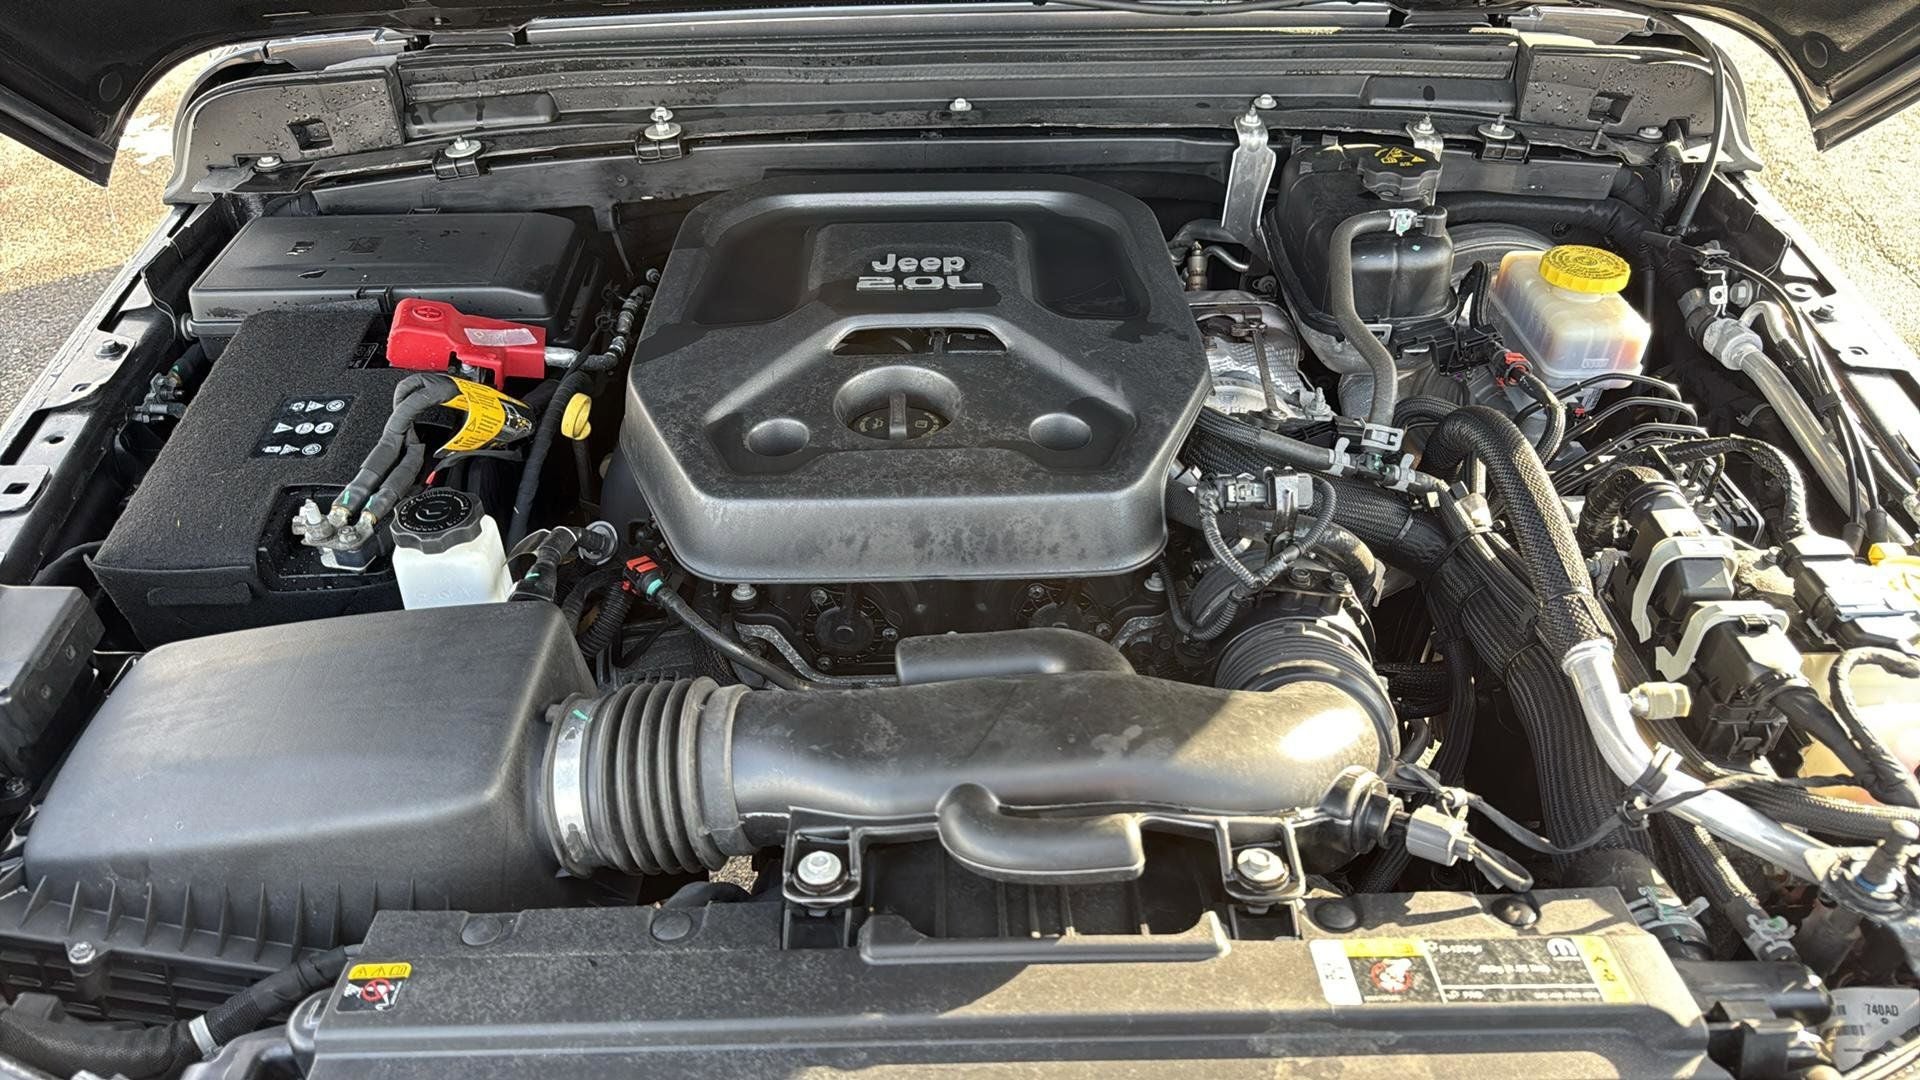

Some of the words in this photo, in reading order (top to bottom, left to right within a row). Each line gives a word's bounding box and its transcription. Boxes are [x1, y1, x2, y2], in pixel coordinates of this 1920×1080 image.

[872, 253, 966, 275] Jeep
[856, 275, 984, 291] 2.0L
[1865, 1004, 1899, 1017] 740AD
